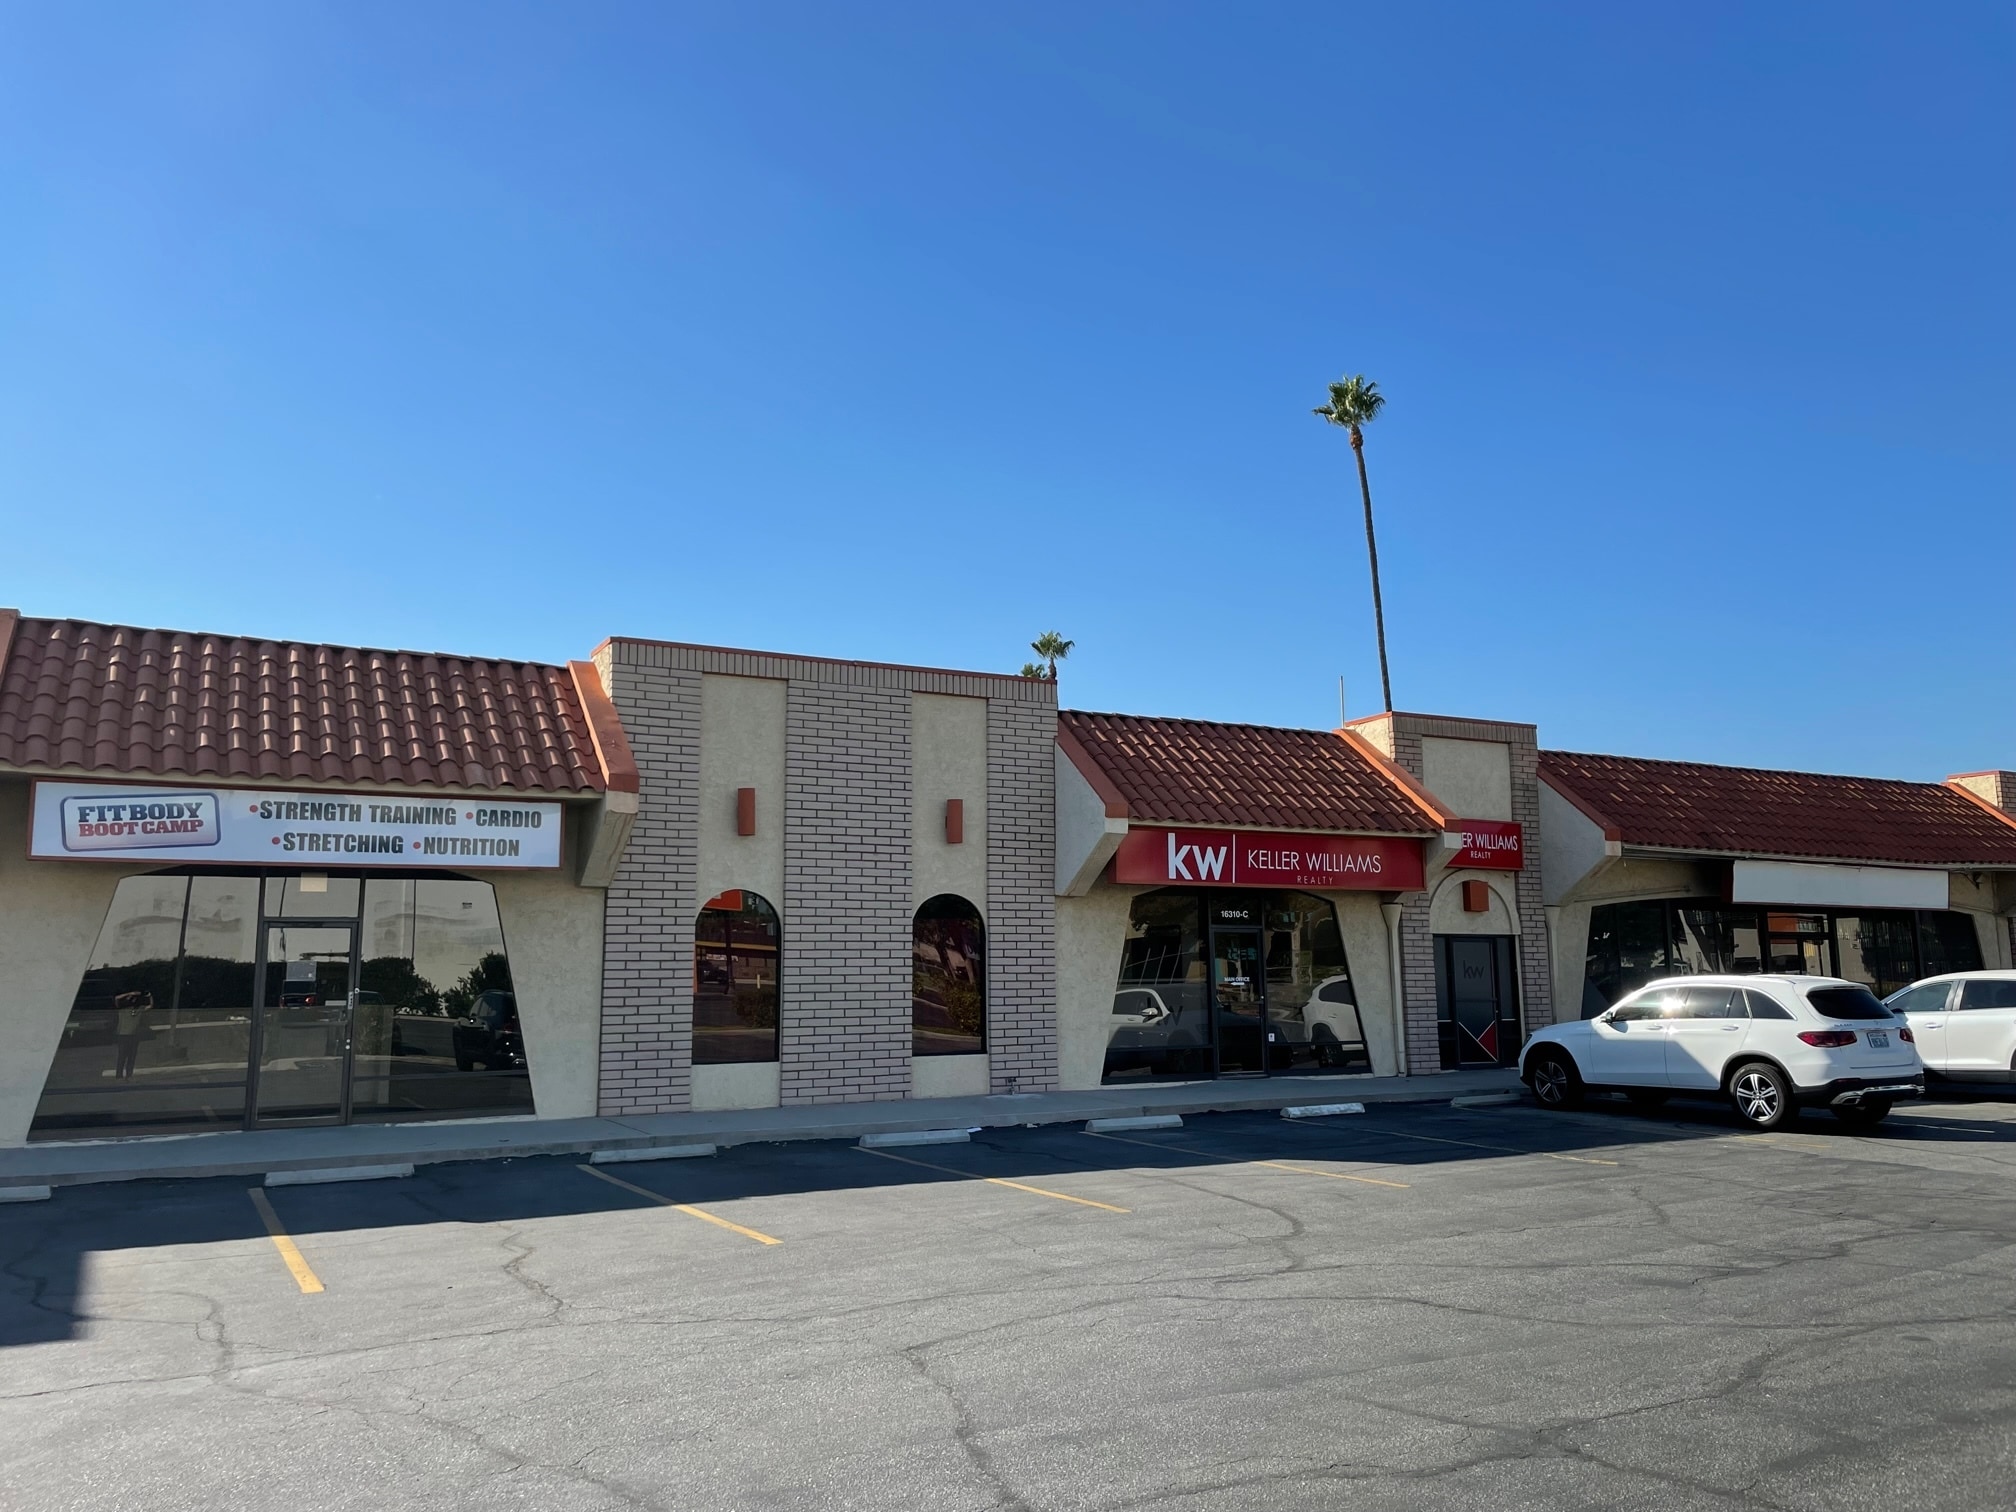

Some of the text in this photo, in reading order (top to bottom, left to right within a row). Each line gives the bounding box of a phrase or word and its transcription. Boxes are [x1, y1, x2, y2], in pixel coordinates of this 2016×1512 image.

[260, 800, 542, 829] STRENGTH TRAINING CARDIO
[79, 819, 204, 837] BOOT CAMP
[283, 832, 520, 857] STRETCHING NUTRITION
[1475, 833, 1519, 851] WILLIAMS
[1167, 832, 1228, 881] kw
[1248, 849, 1382, 874] KELLER WILLIAMS
[1470, 850, 1492, 860] REALTY
[1296, 874, 1334, 886] REALTY
[1220, 910, 1249, 919] 16310-C
[1463, 960, 1485, 980] kw
